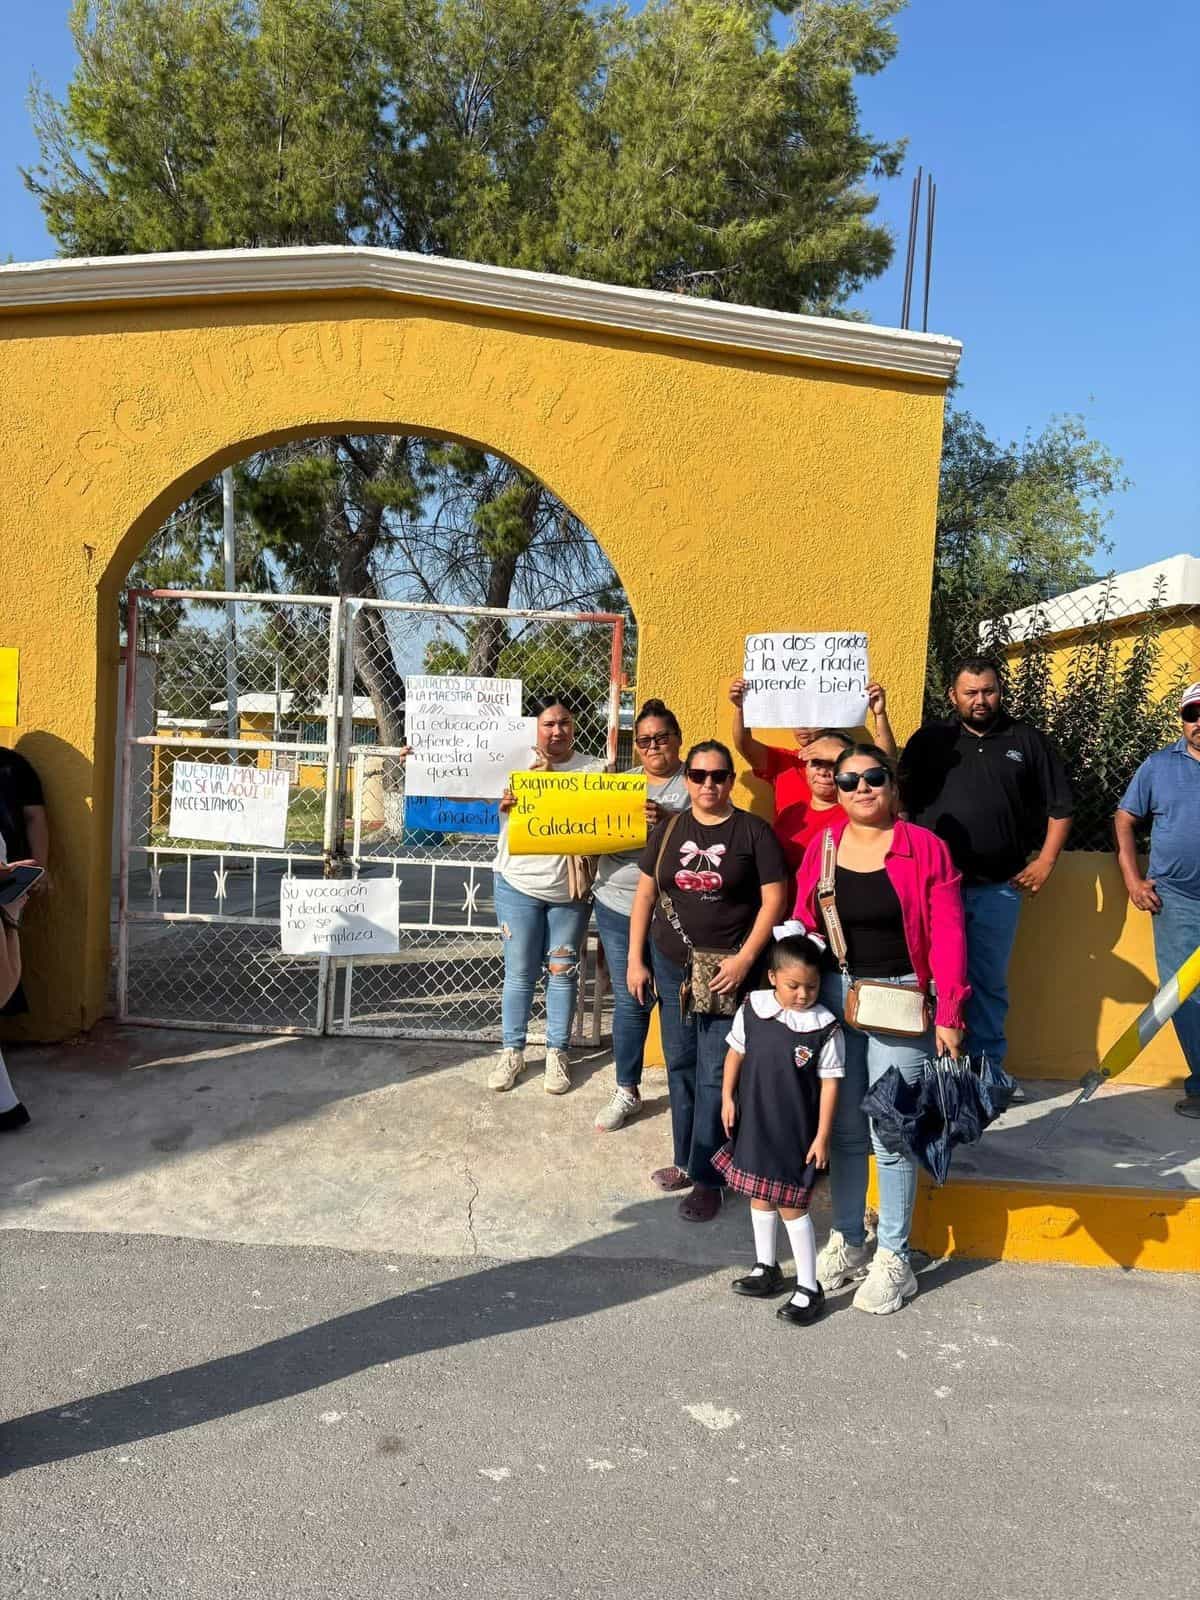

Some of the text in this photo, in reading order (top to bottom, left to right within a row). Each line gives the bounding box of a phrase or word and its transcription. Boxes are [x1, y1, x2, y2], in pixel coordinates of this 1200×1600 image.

[782, 634, 816, 651] dos
[824, 634, 869, 657] grados
[761, 652, 776, 671] la
[782, 658, 816, 673] vez,
[820, 654, 866, 672] nadie
[416, 691, 426, 701] LA
[428, 691, 473, 703] MAESTRA
[477, 692, 510, 706] DULCE!
[508, 720, 526, 732] se
[476, 734, 489, 749] la
[414, 748, 505, 763] maestra se
[175, 762, 229, 780] NUESTRA
[175, 779, 192, 792] NO
[174, 796, 246, 813] NECESITAMOS
[518, 795, 536, 815] de
[527, 816, 597, 837] Calidad
[283, 883, 299, 899] Su
[288, 918, 332, 930] no se
